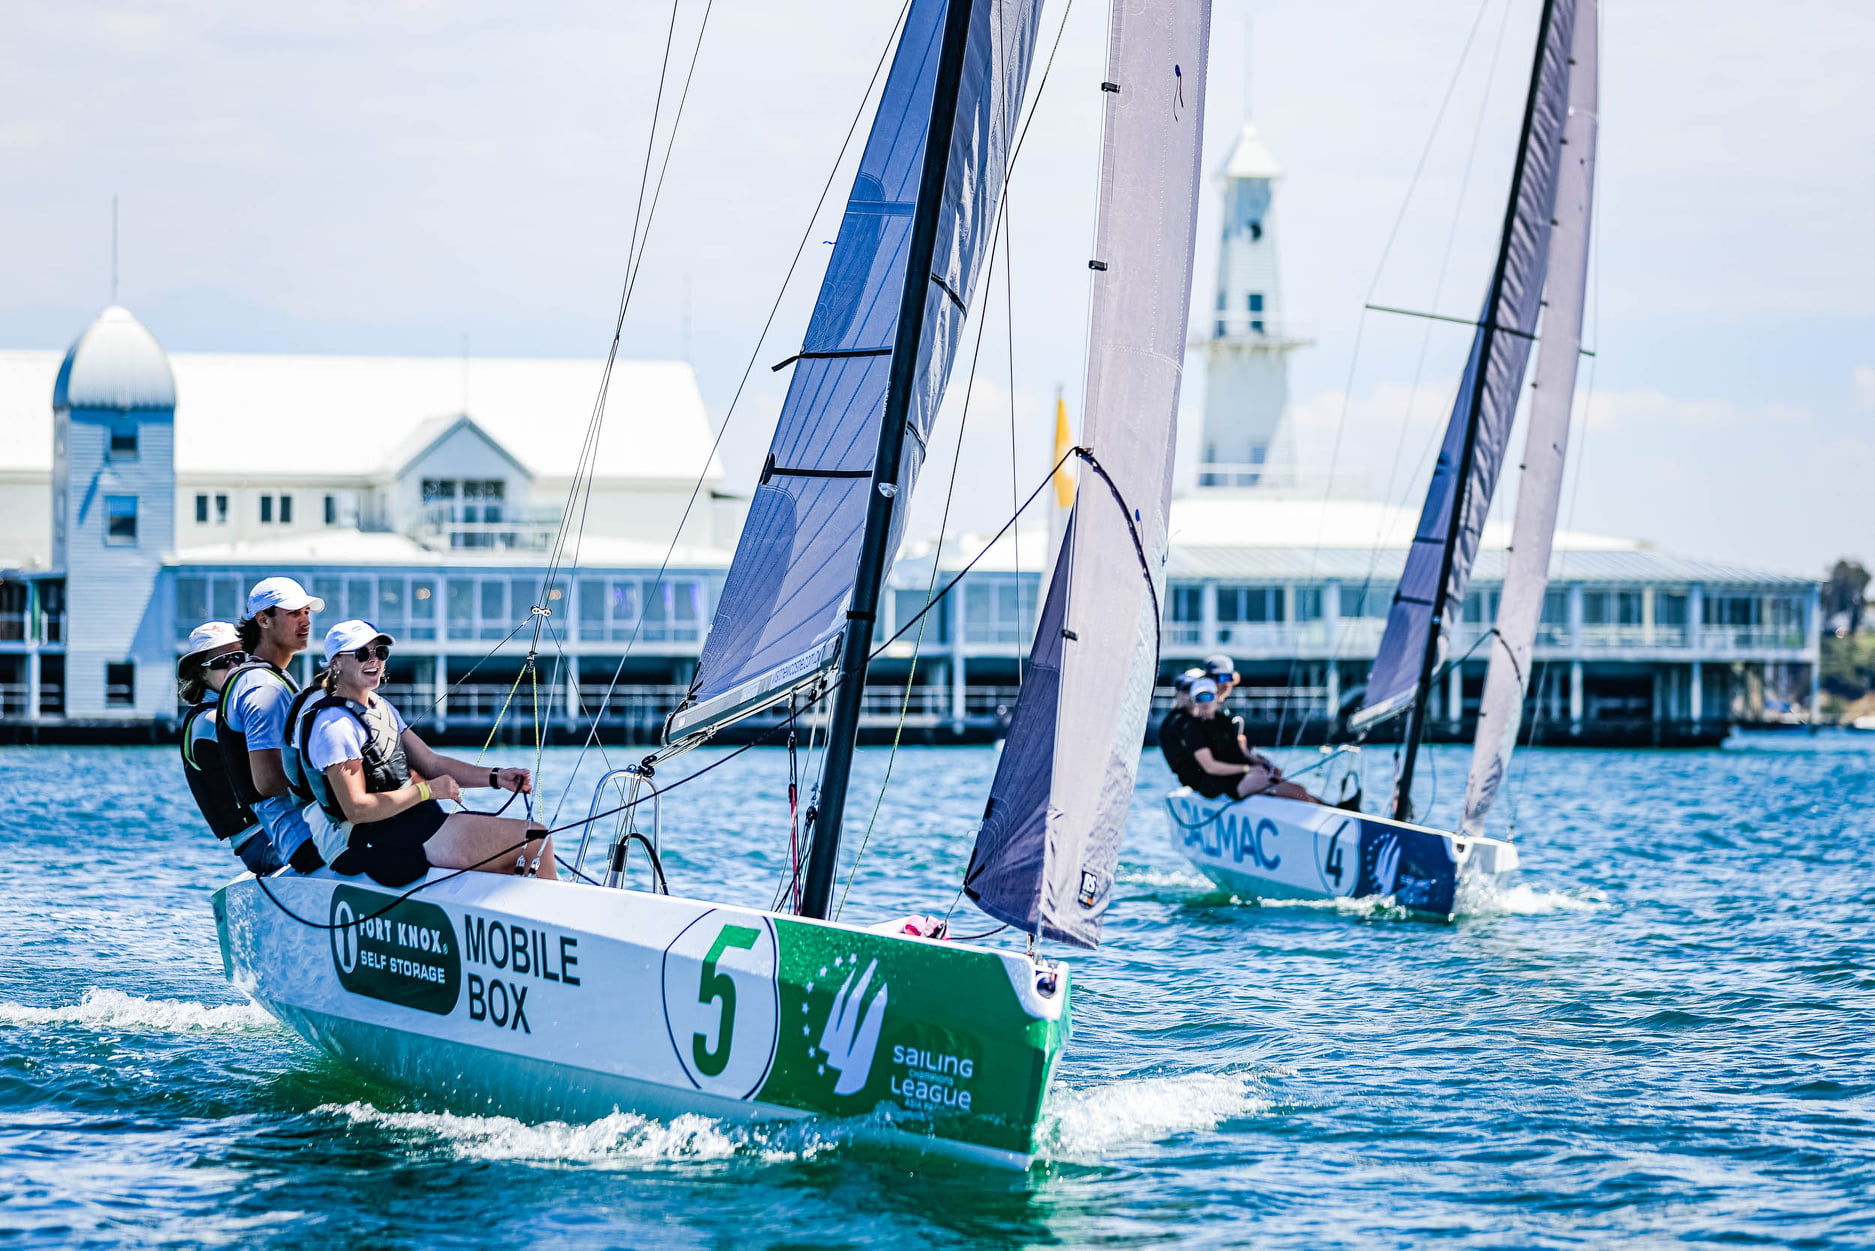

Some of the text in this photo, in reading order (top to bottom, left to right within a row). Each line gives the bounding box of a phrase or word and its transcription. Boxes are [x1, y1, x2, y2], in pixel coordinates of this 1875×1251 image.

[1325, 820, 1350, 888] 4
[359, 913, 391, 942] FORT
[464, 914, 581, 987] MOBILE
[360, 949, 446, 984] SELF STORAGE
[467, 972, 531, 1034] BOX
[692, 924, 762, 1077] 5
